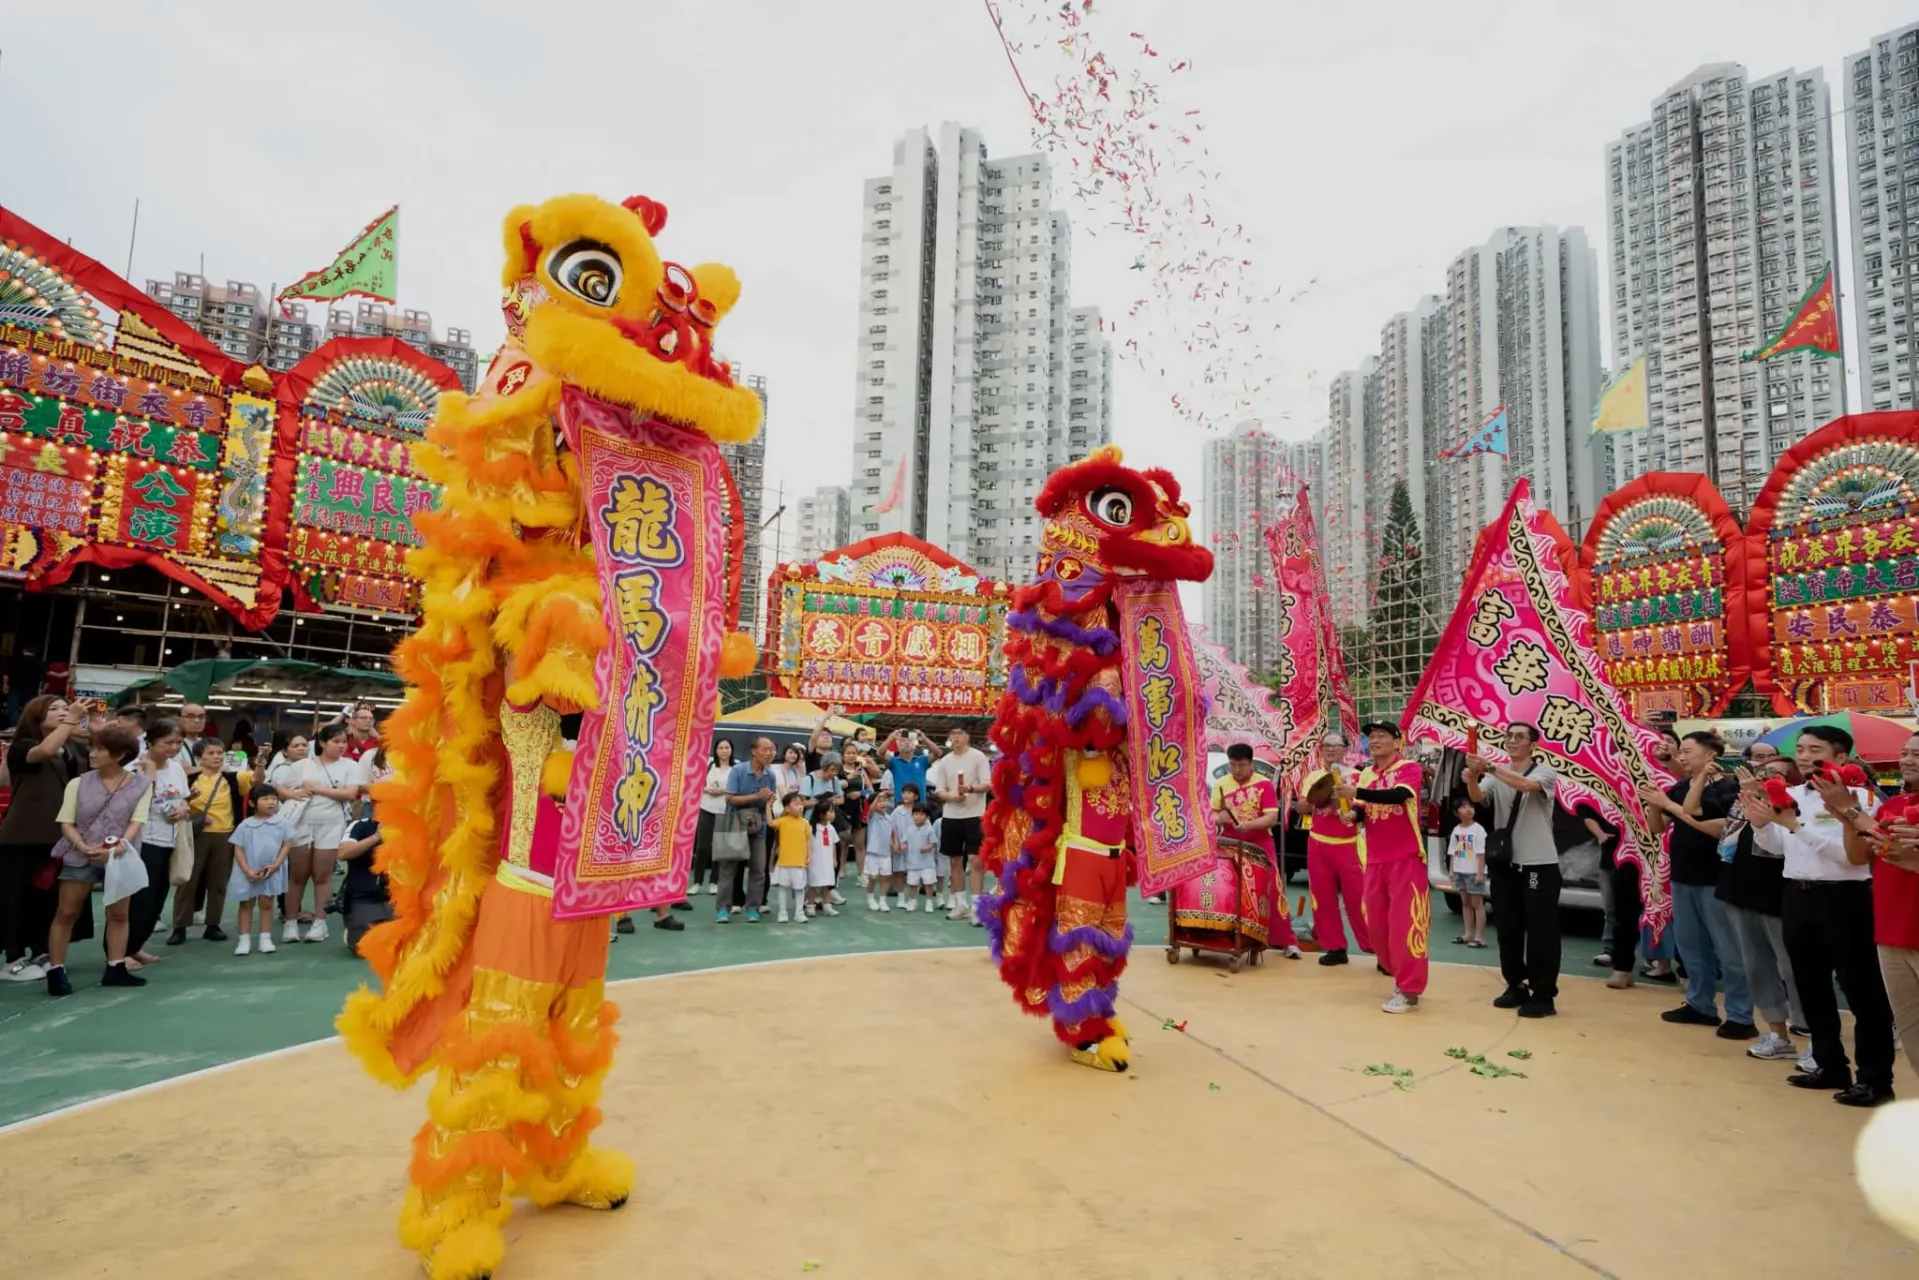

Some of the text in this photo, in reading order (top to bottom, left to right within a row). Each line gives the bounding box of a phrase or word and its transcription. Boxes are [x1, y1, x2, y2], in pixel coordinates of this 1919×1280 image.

[0, 393, 211, 465] 恭祝真君
[303, 461, 327, 501] 先生
[328, 467, 433, 519] 郭良興
[129, 470, 190, 546] 公演
[1602, 558, 1715, 599] 青衣各界恭祝
[1600, 591, 1717, 628] 真君大帝寶誕
[1787, 600, 1919, 638] 泰民安
[601, 472, 685, 848] 龍馬精神
[810, 618, 980, 662] 葵青戲棚
[1608, 623, 1715, 657] 酬謝神恩
[1137, 615, 1188, 844] 萬事如意
